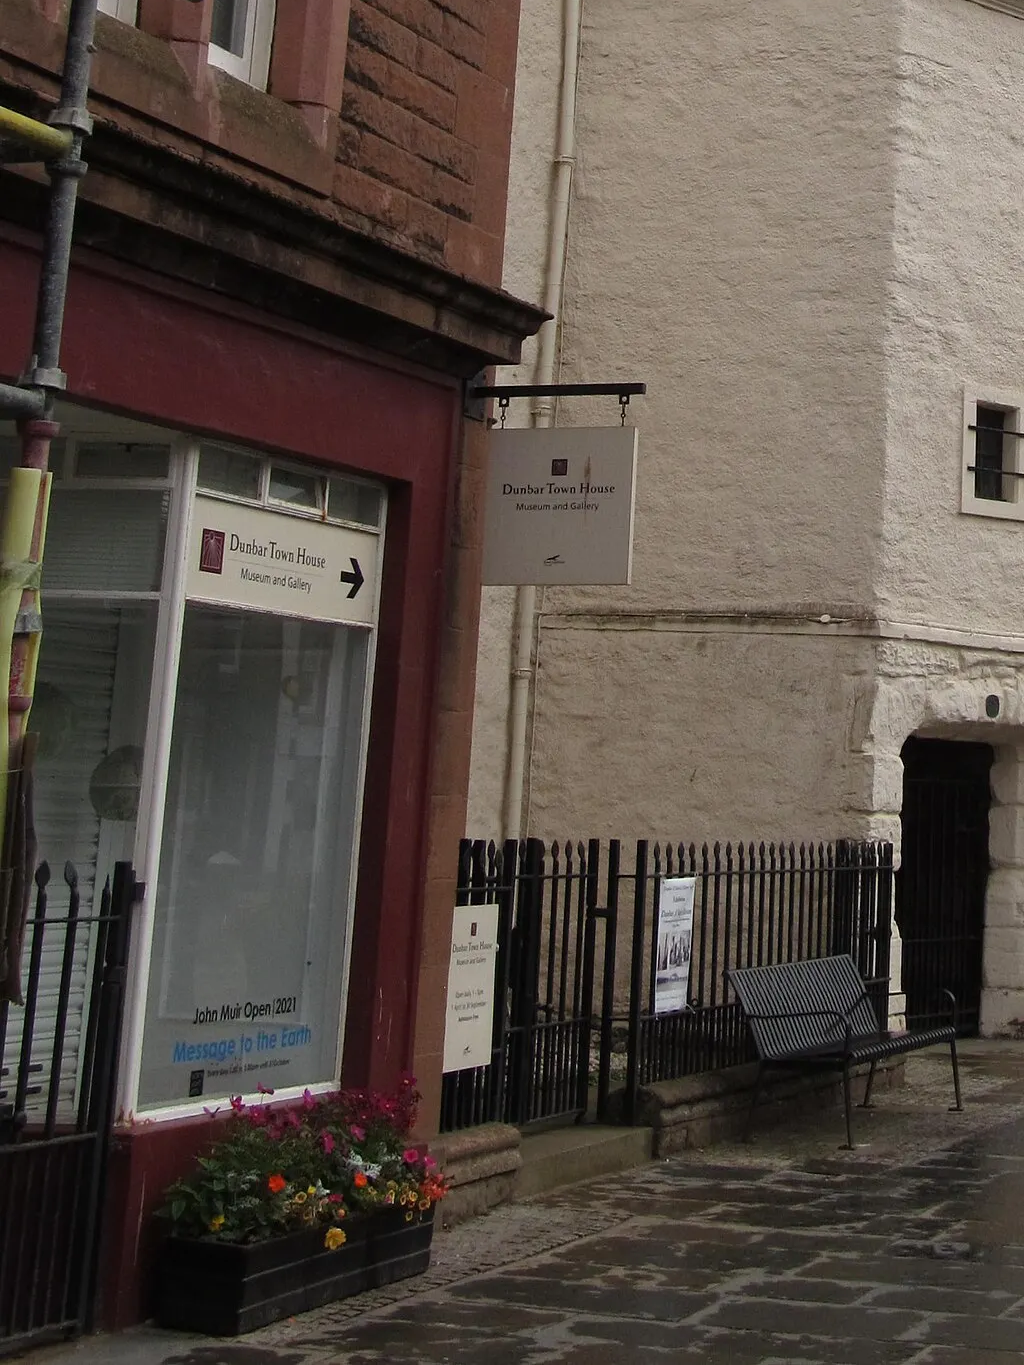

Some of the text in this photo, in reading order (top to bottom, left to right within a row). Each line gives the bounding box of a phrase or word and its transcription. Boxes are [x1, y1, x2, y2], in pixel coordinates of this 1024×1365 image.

[503, 482, 616, 495] Dunbar Town House
[516, 501, 599, 511] Museum and Gallery
[229, 534, 327, 569] Dunbar Town House
[240, 568, 312, 594] Museum and Gallery
[193, 1006, 218, 1024] John
[220, 1003, 241, 1022] Muir
[244, 1002, 271, 1021] Open
[173, 1024, 312, 1063] Message to the Earth
